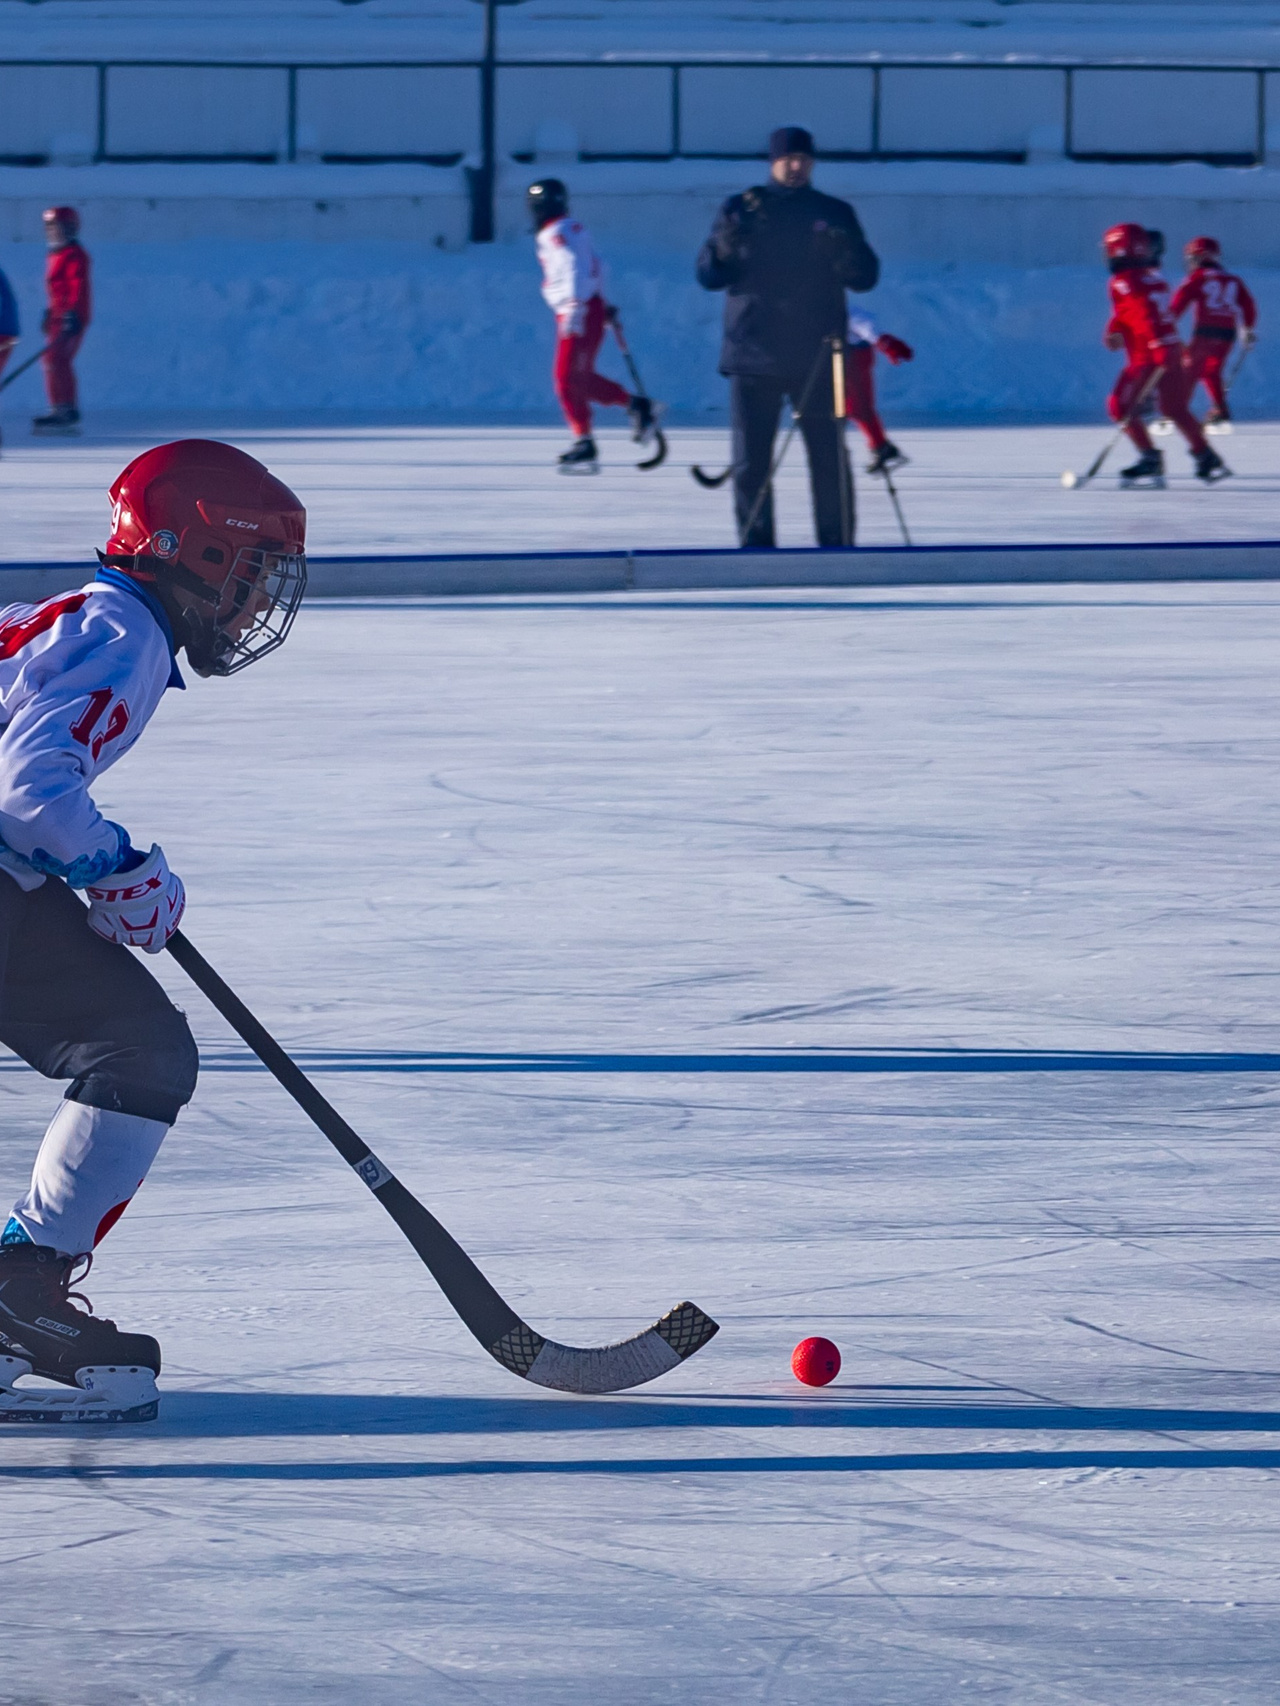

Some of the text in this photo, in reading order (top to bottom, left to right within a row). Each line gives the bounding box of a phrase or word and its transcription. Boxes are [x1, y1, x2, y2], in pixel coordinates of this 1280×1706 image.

[225, 518, 260, 531] CCM
[86, 868, 163, 903] STEX
[35, 1316, 81, 1338] BAUER
